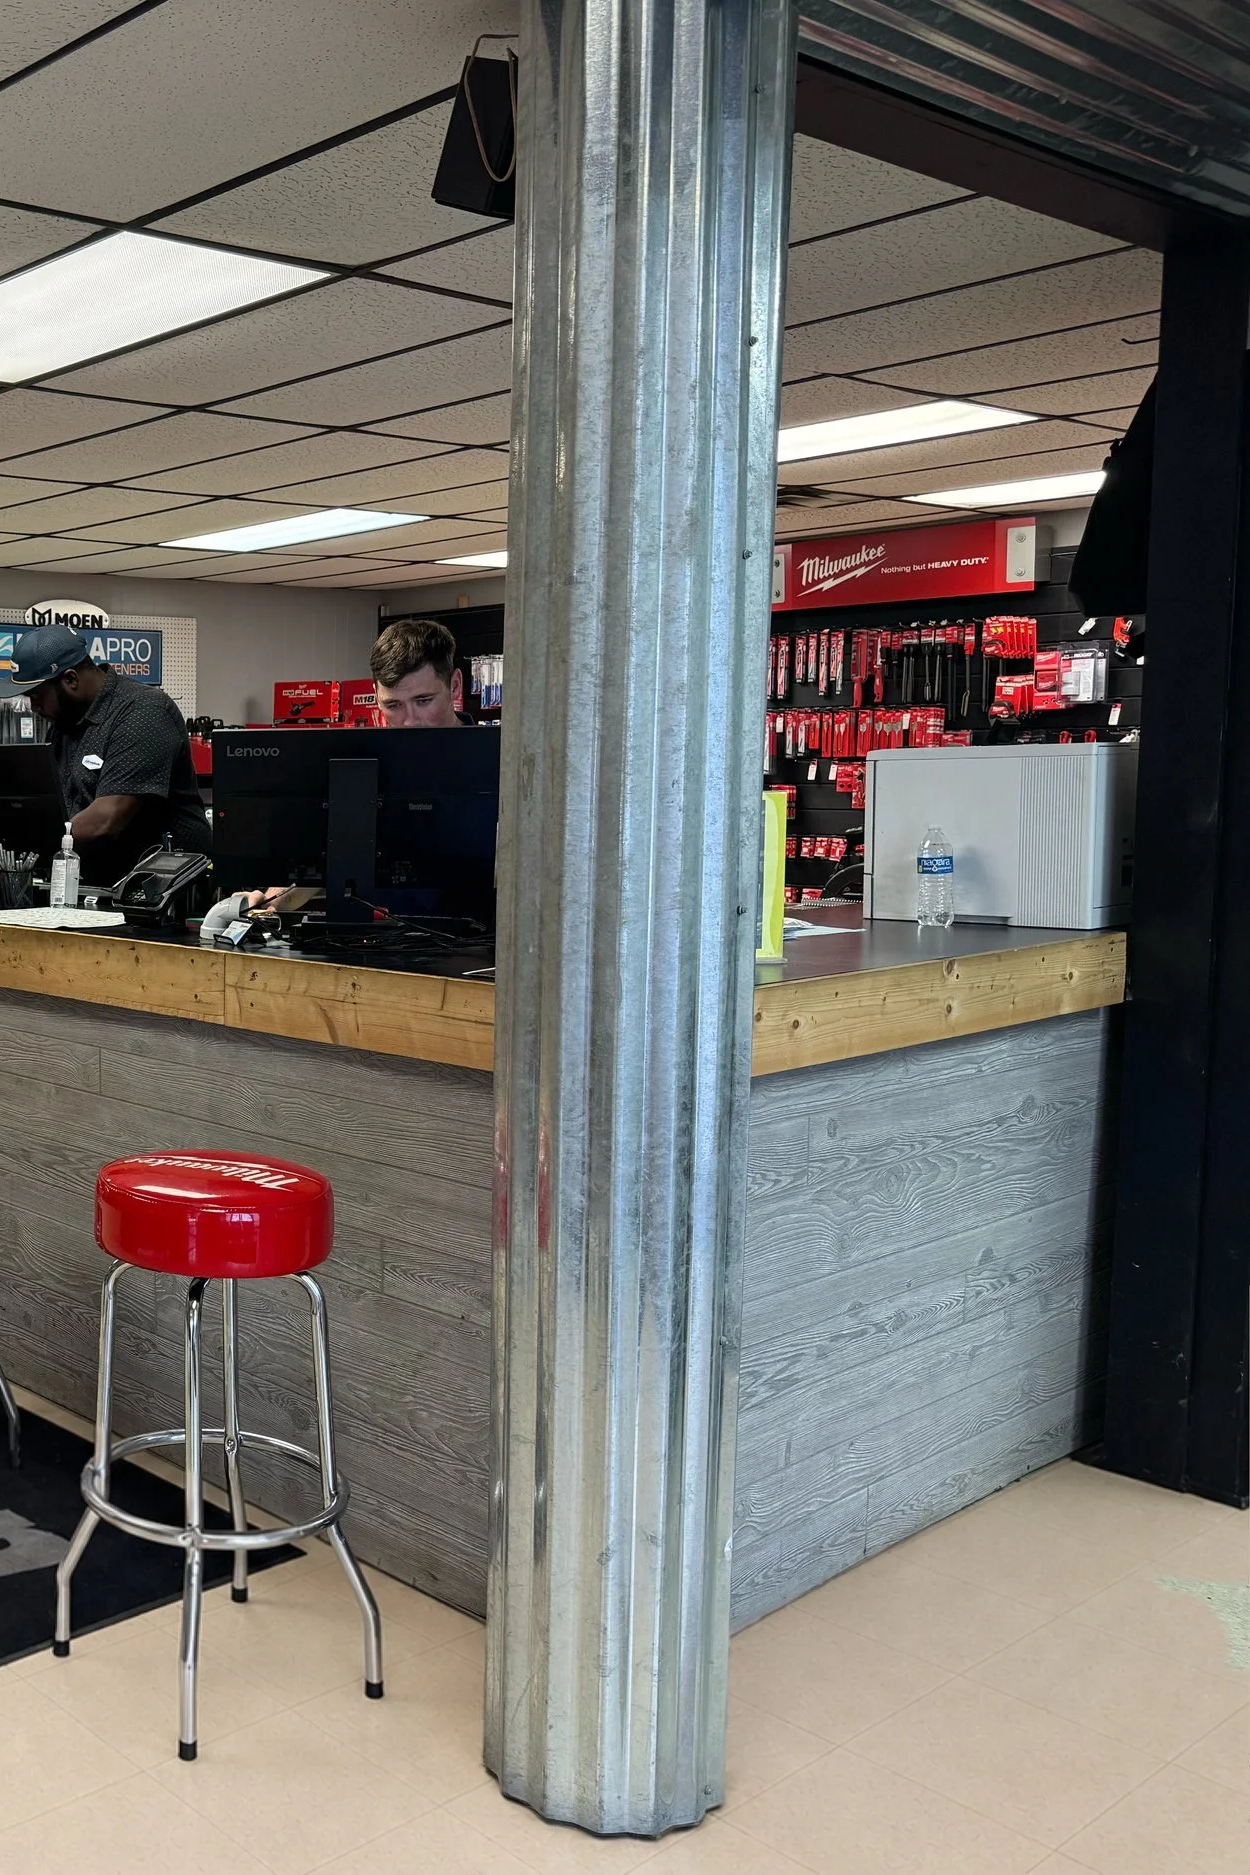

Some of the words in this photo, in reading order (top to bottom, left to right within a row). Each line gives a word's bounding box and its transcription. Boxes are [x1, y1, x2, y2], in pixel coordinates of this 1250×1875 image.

[796, 543, 886, 586] Milwaukee
[881, 564, 911, 574] Nothing
[913, 563, 926, 571] but
[927, 560, 959, 570] HEAVY
[54, 613, 103, 628] MOEN
[354, 695, 376, 704] M18
[226, 745, 280, 757] Lenovo
[124, 1155, 298, 1191] Milwaukee
